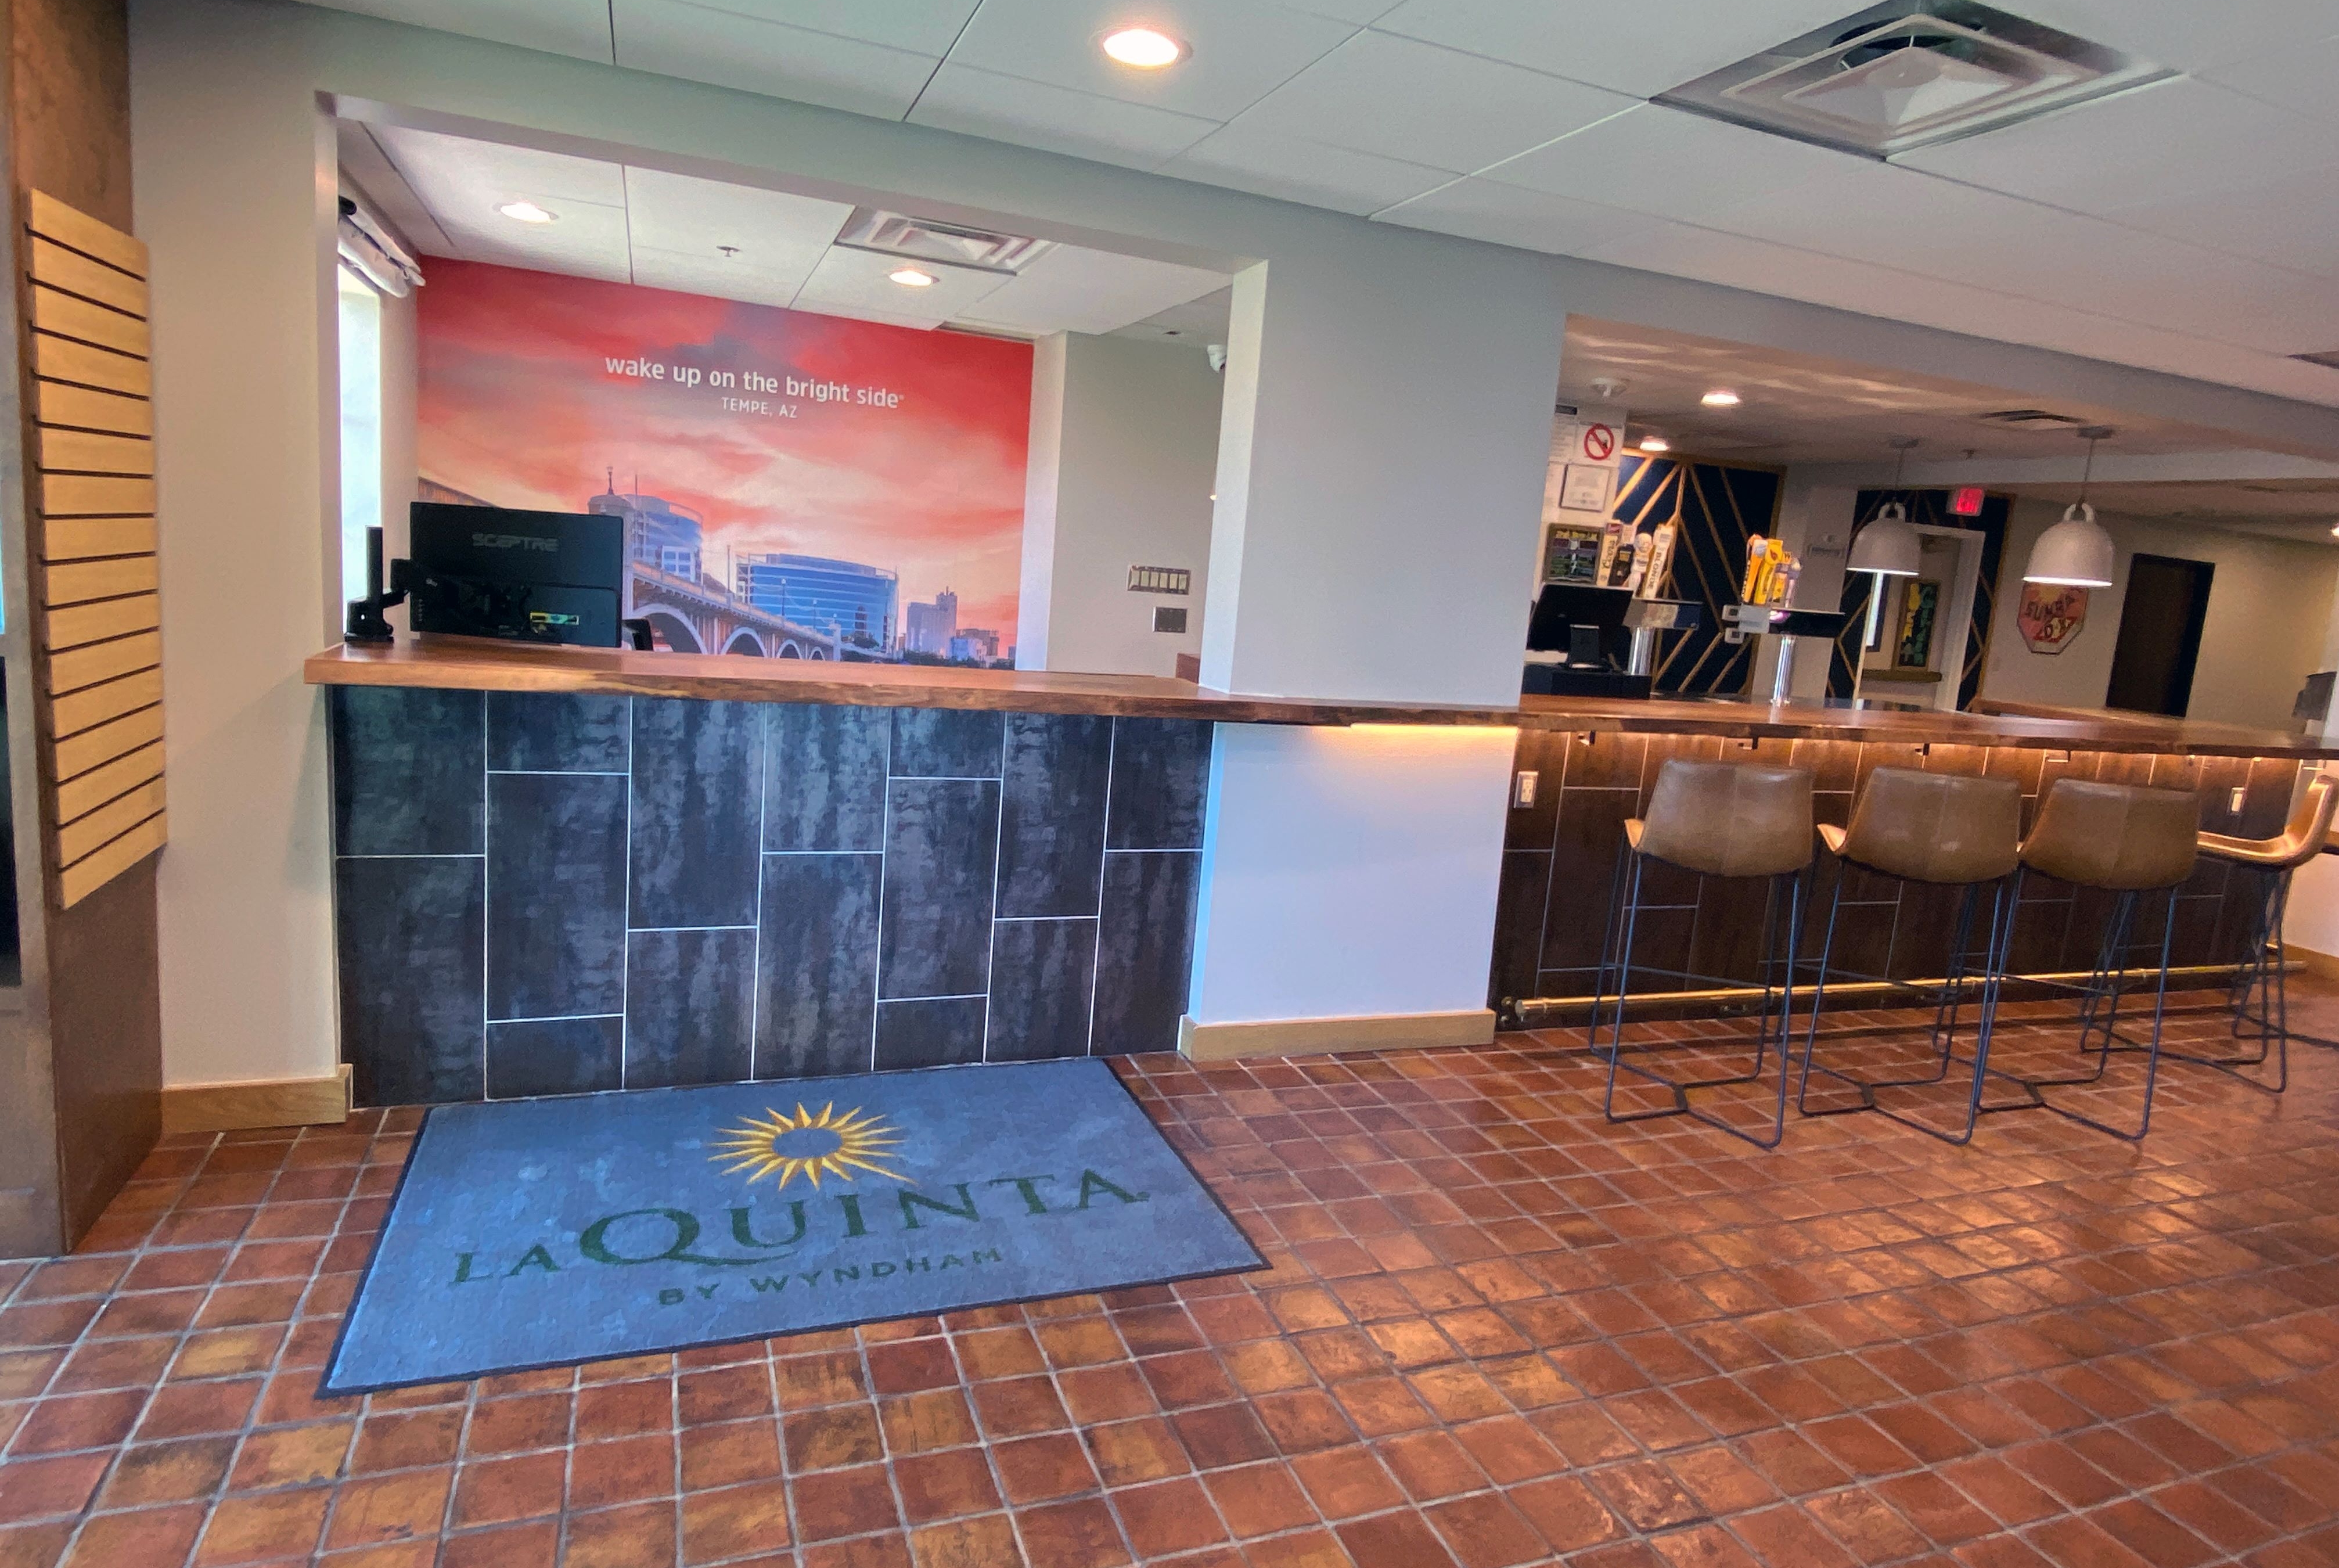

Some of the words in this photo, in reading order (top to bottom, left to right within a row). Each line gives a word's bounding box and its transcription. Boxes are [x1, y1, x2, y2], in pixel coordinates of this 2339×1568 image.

[605, 357, 665, 380] wake
[673, 366, 701, 388] up
[709, 371, 735, 389] on
[743, 372, 778, 394] the
[786, 376, 850, 402] bright
[857, 386, 899, 408] side
[721, 397, 773, 417] TEMPE,
[779, 404, 798, 419] AZ
[472, 533, 559, 552] SCEPTRE
[450, 1244, 561, 1286] LA
[581, 1168, 1150, 1267] QUINTA
[658, 1283, 721, 1306] BY
[749, 1236, 1003, 1293] WYNDHAM
